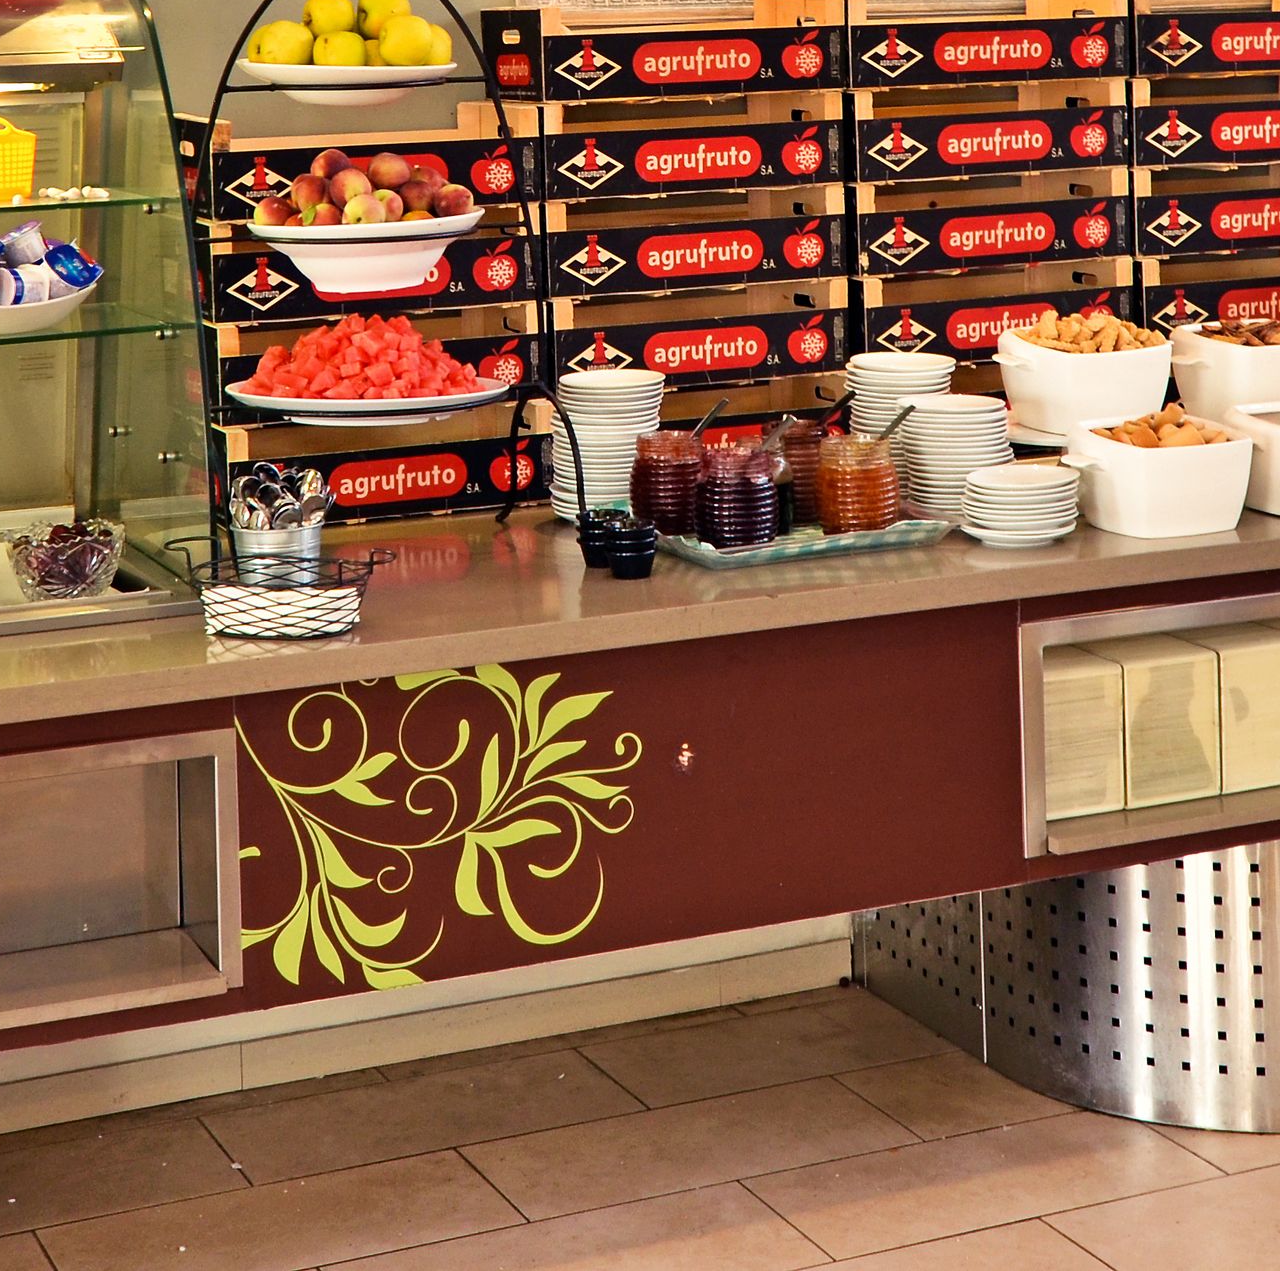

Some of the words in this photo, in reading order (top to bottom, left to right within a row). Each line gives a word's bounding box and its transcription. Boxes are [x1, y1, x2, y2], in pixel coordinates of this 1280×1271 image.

[644, 46, 751, 76] agrufruto
[943, 36, 1043, 65] agrufruto
[947, 127, 1043, 158] agrufruto
[645, 143, 752, 175] agrufruto
[949, 220, 1046, 251] agrufruto
[647, 238, 753, 270] agrufruto
[763, 259, 777, 269] S.A.
[956, 311, 1039, 343] agrufrut
[654, 334, 758, 367] agrufruto
[340, 464, 456, 499] agrufruto
[466, 483, 482, 494] S.A.
